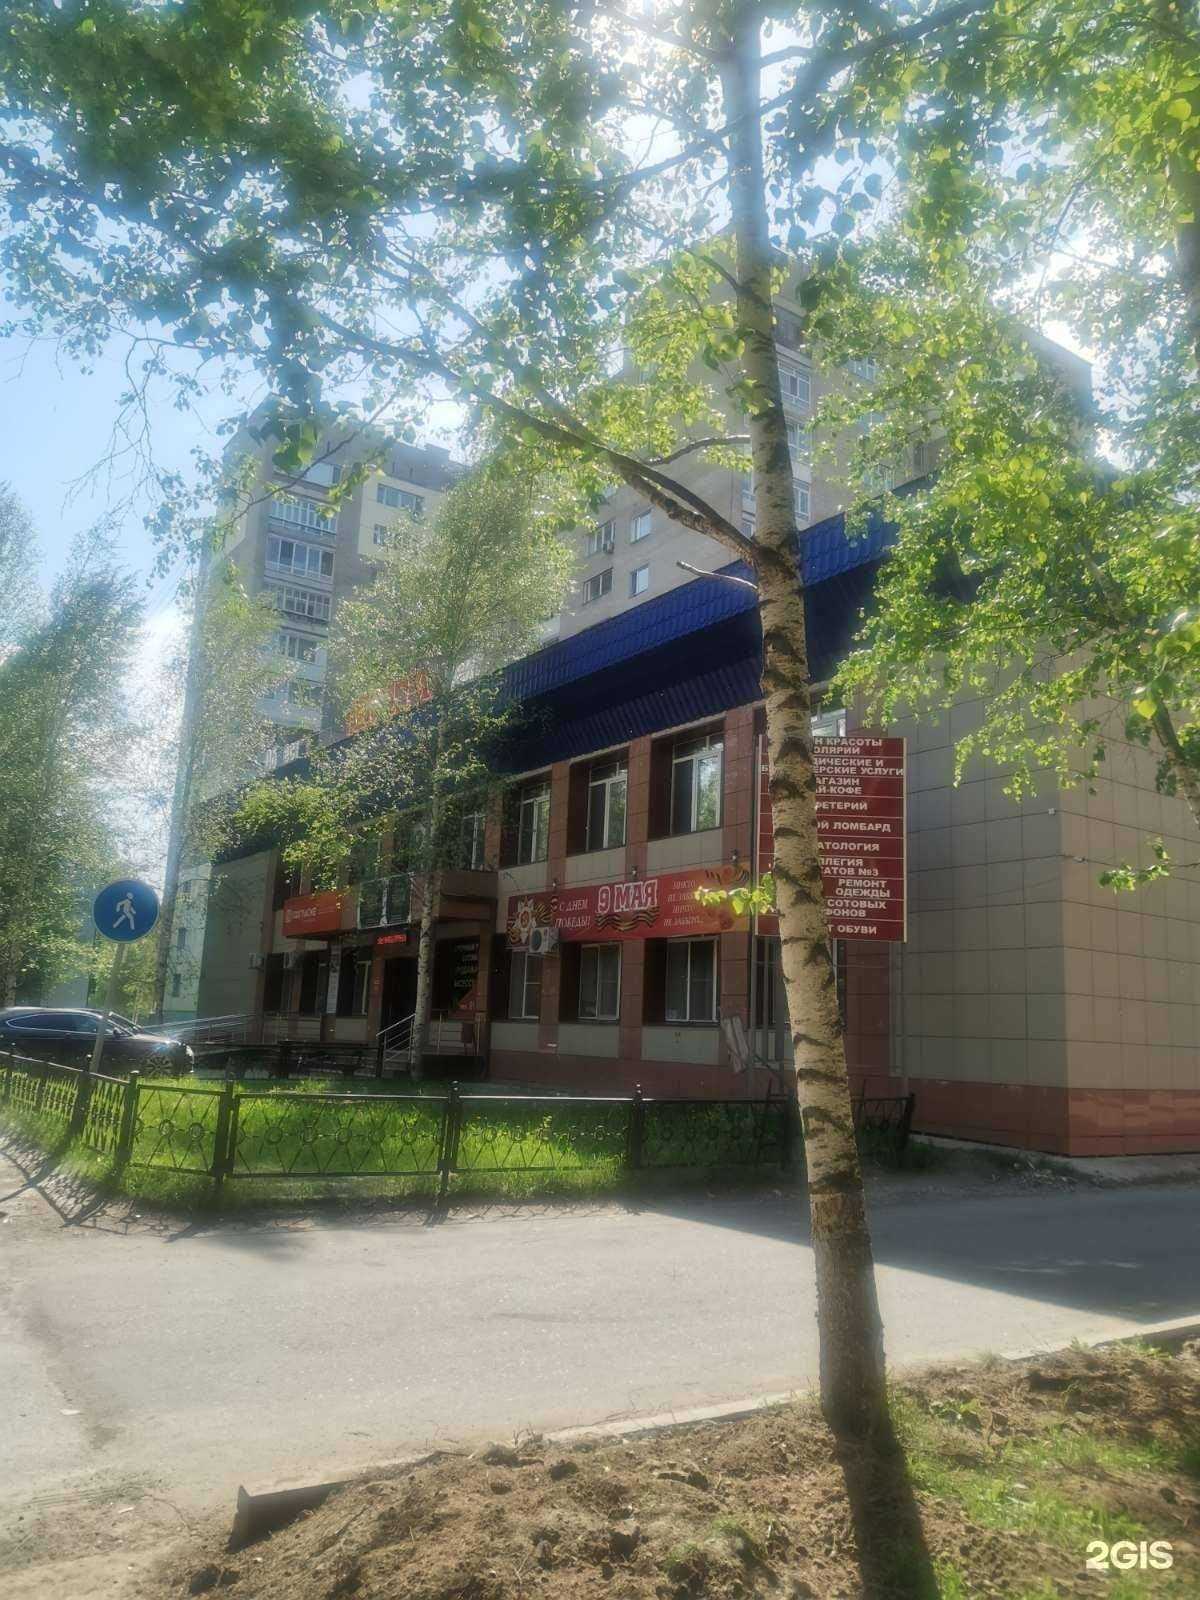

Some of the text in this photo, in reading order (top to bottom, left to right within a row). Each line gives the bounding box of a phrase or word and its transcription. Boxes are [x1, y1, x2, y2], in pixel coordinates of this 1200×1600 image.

[826, 738, 882, 747] КРАСОТЫ
[814, 746, 860, 754] ОЛЯРИЙ
[814, 767, 904, 776] ЕРСКИЕ УСЛУГИ
[815, 777, 860, 785] АГАЗИН
[815, 785, 862, 794] Й-КОФЕ
[833, 821, 891, 833] ЛОМБАРД
[817, 841, 880, 852] АТОЛОГИЯ
[822, 866, 855, 875] АТОВ
[838, 878, 888, 888] РЕМОНТ
[598, 879, 658, 914] 9 МАЯ
[835, 888, 890, 898] ОДЕЖДЫ
[827, 899, 887, 909] СОТОВЫХ
[837, 925, 877, 934] ОБУВИ
